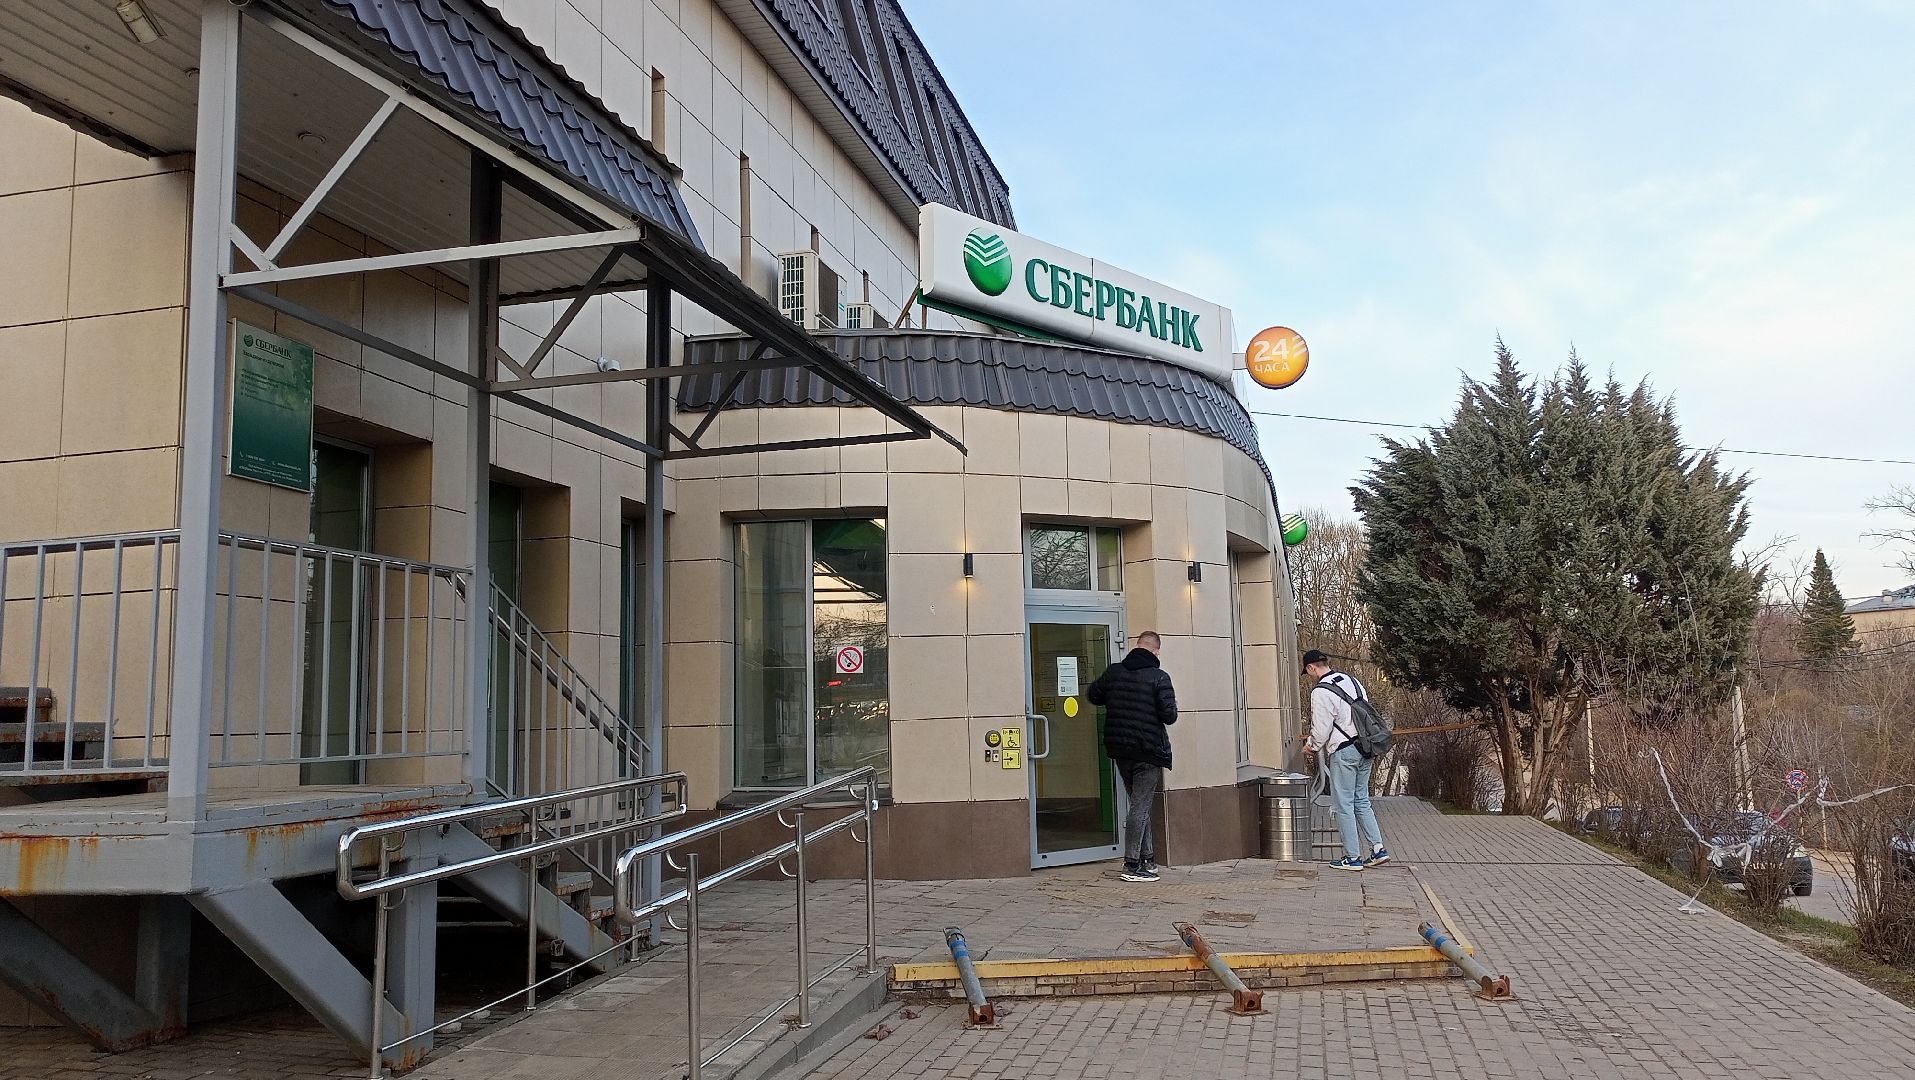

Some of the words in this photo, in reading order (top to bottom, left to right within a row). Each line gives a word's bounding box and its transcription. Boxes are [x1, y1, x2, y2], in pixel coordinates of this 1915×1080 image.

[1025, 257, 1203, 352] СБЕРБАНК
[255, 338, 292, 359] СБЕРБАНК
[1253, 338, 1290, 363] 24
[1254, 362, 1290, 374] ЧАСА
